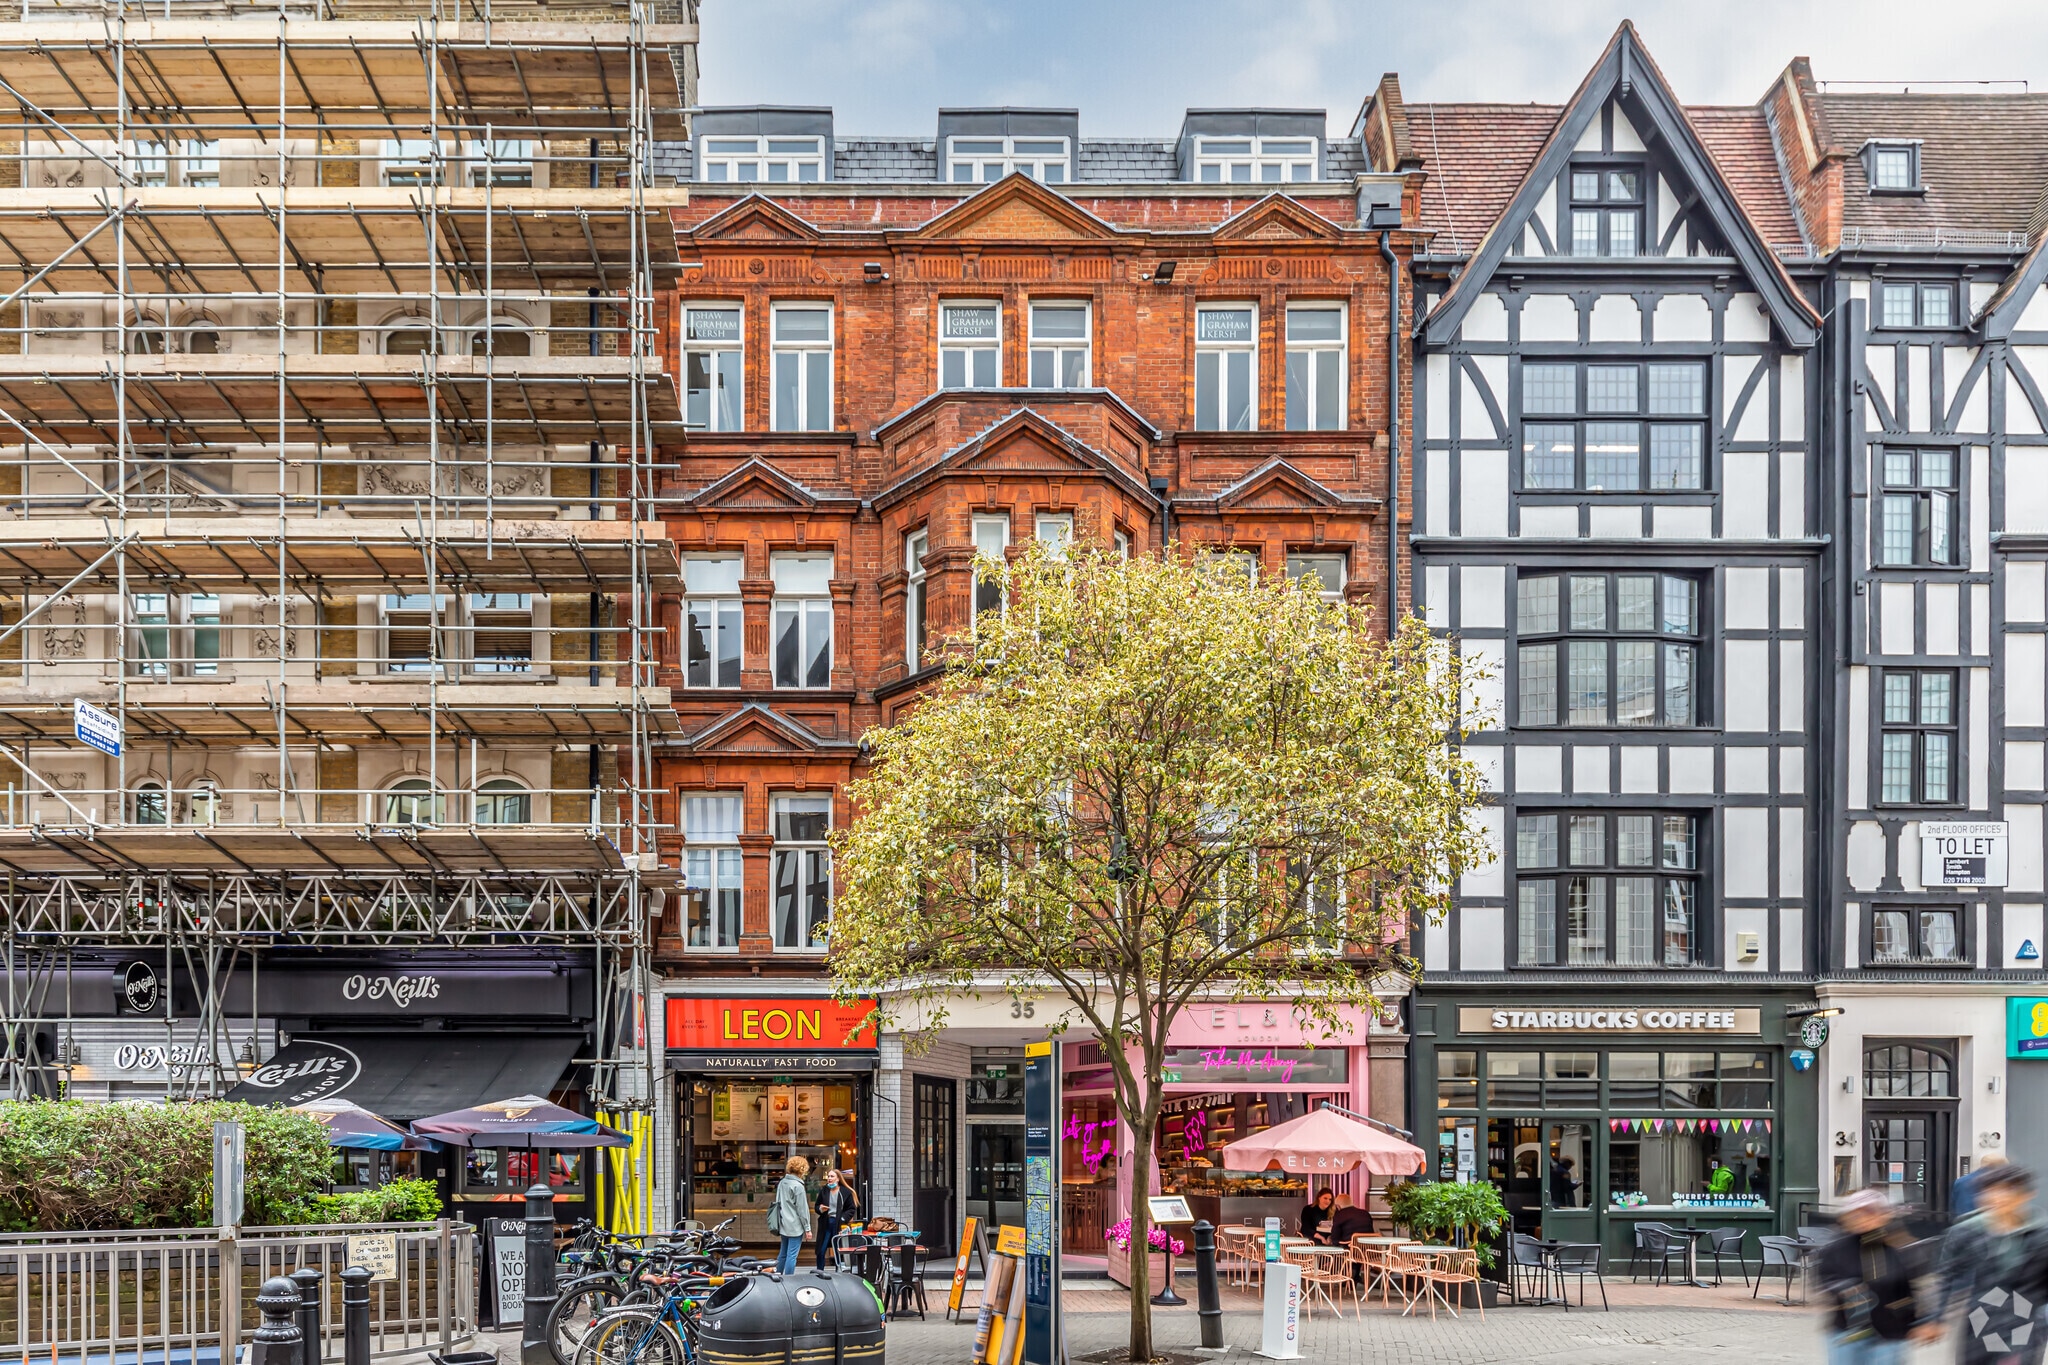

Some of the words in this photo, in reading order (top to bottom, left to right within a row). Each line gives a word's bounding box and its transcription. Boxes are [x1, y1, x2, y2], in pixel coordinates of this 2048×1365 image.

[696, 311, 723, 320] SHAW
[952, 309, 979, 318] SHAW
[1207, 312, 1235, 320] SHAW
[695, 320, 738, 330] GRAHAM
[952, 318, 994, 326] GRAHAM
[1206, 321, 1249, 330] GRAHAM
[697, 329, 726, 338] KERSH
[952, 326, 982, 335] KERSH
[1207, 330, 1237, 338] KERSH
[79, 704, 117, 731] Assure
[1928, 826, 1940, 834] 2nd
[1943, 825, 1968, 834] FLOOR
[1970, 824, 2002, 834] OFFICES
[1936, 838, 1957, 854] TO
[1964, 838, 1994, 854] LET
[128, 976, 154, 995] O'Neill's
[342, 974, 440, 1008] O'Neill's
[1011, 1002, 1034, 1018] 35
[724, 1008, 821, 1040] LEON
[1492, 1010, 1638, 1029] STARBUCKS
[1642, 1010, 1735, 1029] COFFEE
[706, 1058, 769, 1067] NATURALLY
[774, 1058, 799, 1067] FAST
[806, 1058, 837, 1067] FOOD
[1200, 1046, 1232, 1071] Take
[1236, 1050, 1256, 1072] Me
[1258, 1050, 1298, 1084] Away
[290, 1076, 340, 1102] ENJOY
[1836, 1131, 1858, 1147] 34
[501, 1251, 516, 1260] WE
[1286, 1282, 1298, 1340] CARNABY
